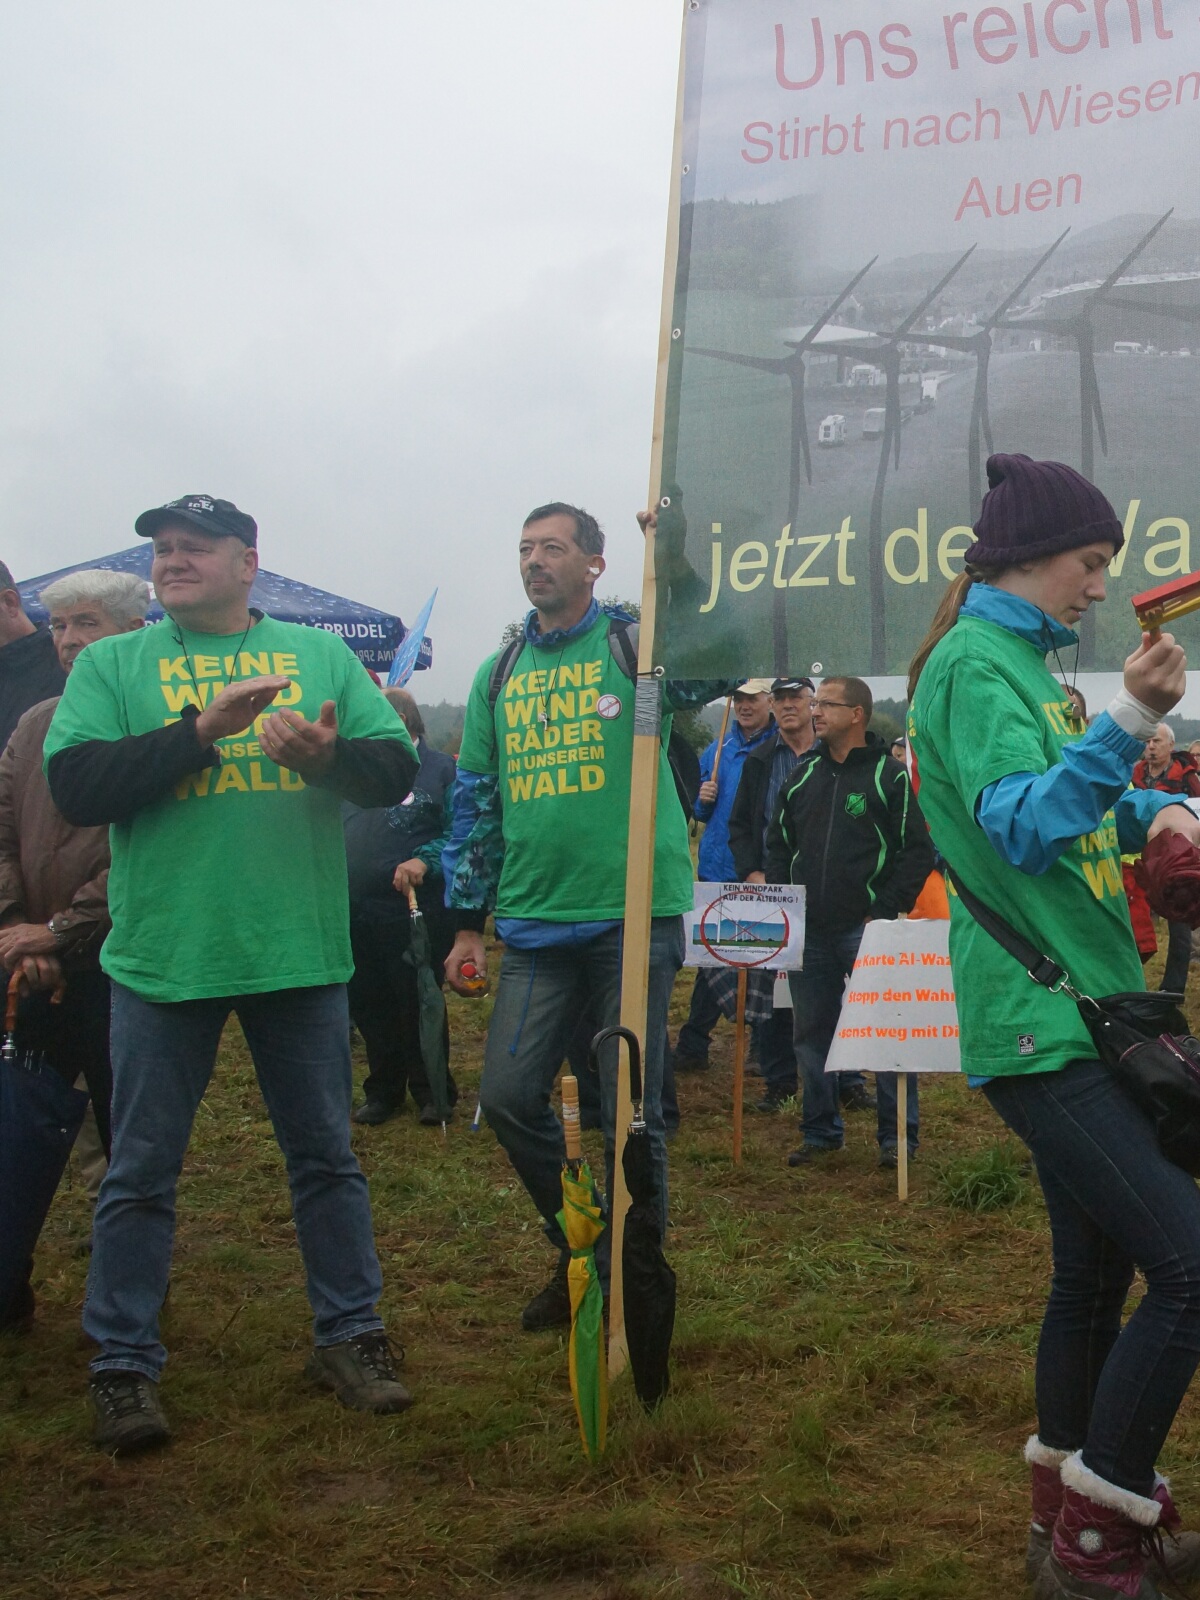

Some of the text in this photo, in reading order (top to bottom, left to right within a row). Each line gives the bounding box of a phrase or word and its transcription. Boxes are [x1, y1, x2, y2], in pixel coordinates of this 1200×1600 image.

[775, 17, 918, 90] Uns
[741, 112, 865, 164] Stirbt
[883, 98, 1000, 150] nach
[1018, 71, 1200, 137] Wiesen
[954, 172, 1082, 221] Auen
[699, 515, 856, 613] jetzt
[159, 652, 300, 681] KEINE
[505, 660, 603, 698] KEINE
[504, 687, 600, 728] WIND
[505, 719, 604, 755] RÄDER
[507, 746, 605, 774] IN UNSEREM
[508, 765, 606, 803] WALD
[723, 884, 783, 893] KEIN WINDPARK
[756, 895, 793, 903] ALTEBURG
[863, 953, 895, 967] Karte
[848, 990, 879, 1005] Stopp
[882, 988, 912, 1002] den
[875, 1028, 908, 1042] weg
[911, 1026, 938, 1038] mit
